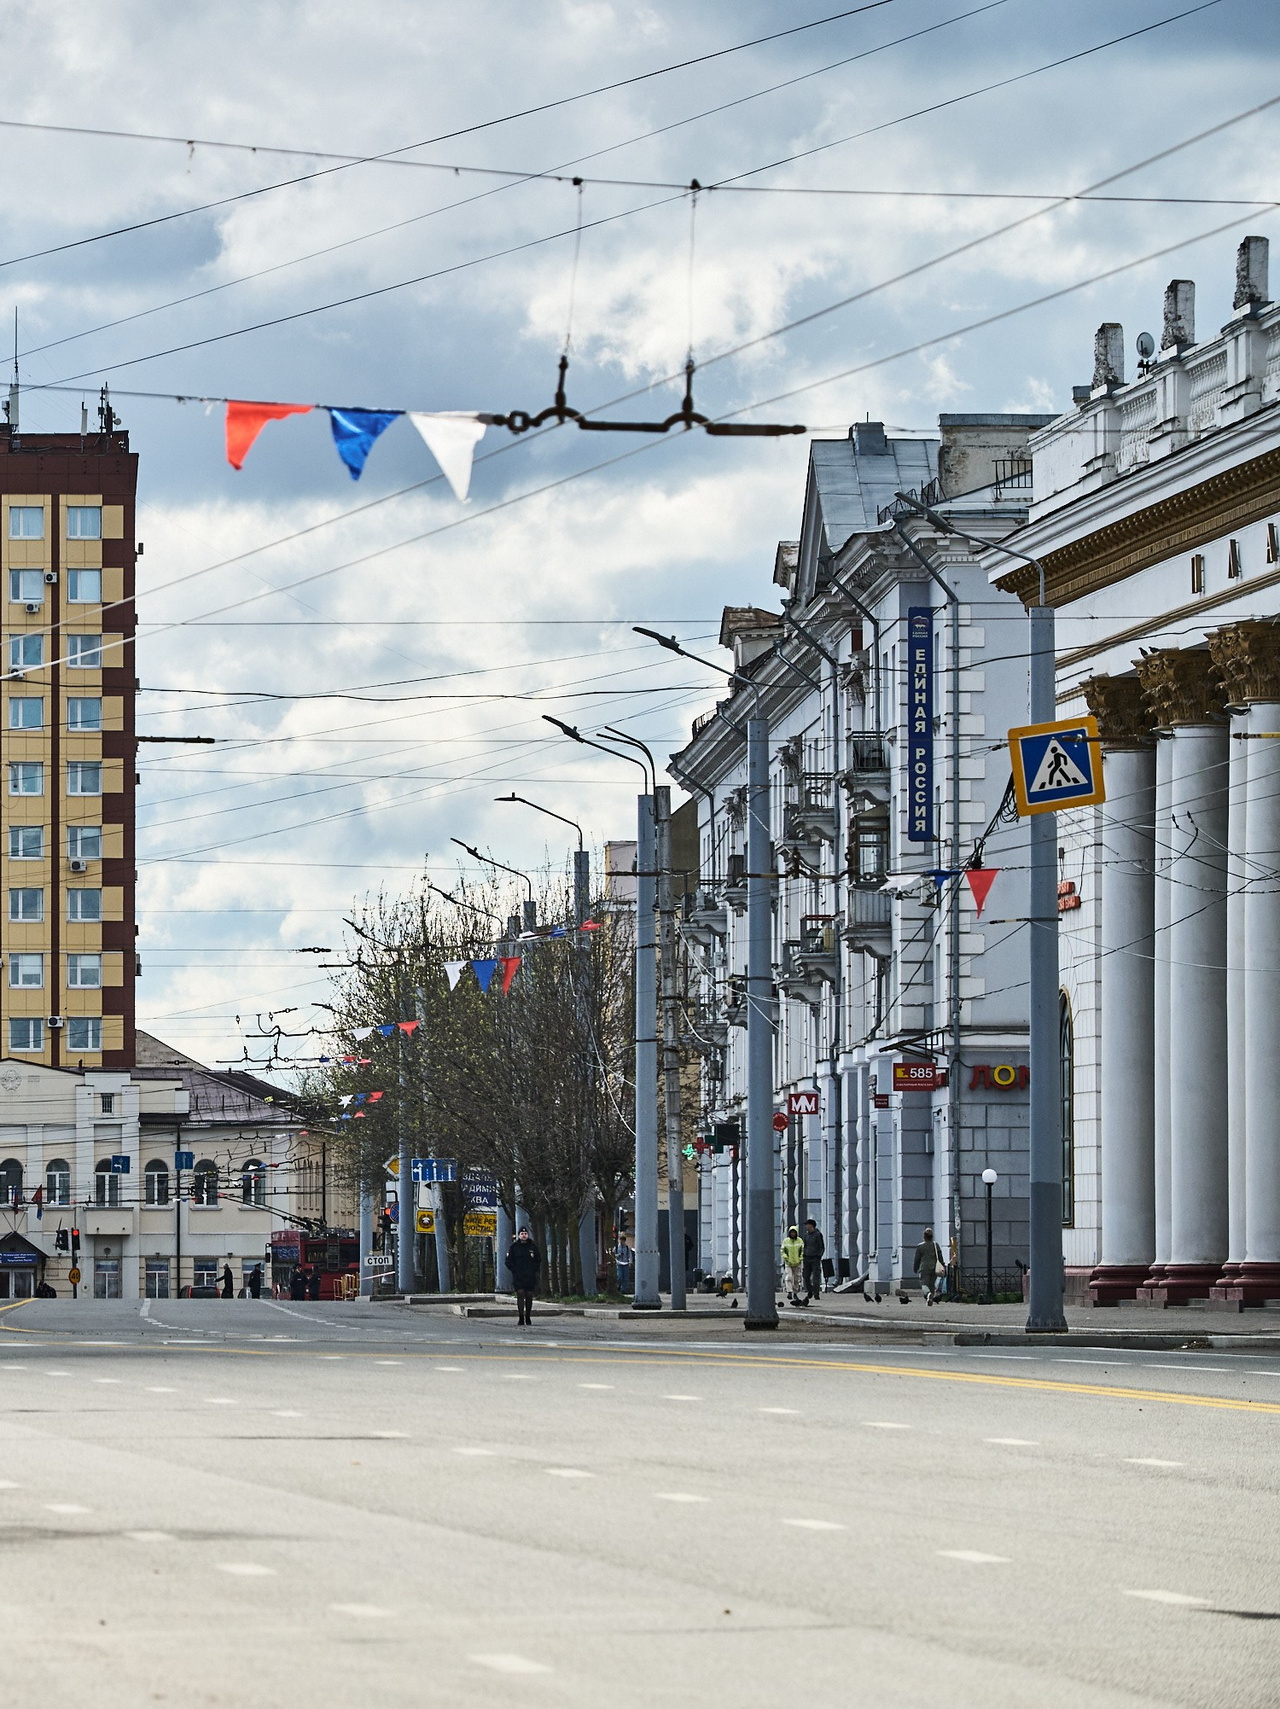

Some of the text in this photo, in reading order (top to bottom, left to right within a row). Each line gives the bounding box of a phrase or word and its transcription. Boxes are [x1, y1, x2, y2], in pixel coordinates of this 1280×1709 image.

[914, 649, 927, 832] ЕДИНАЯ РОССИЯ
[909, 1067, 933, 1079] 585
[367, 1257, 390, 1265] СТОП
